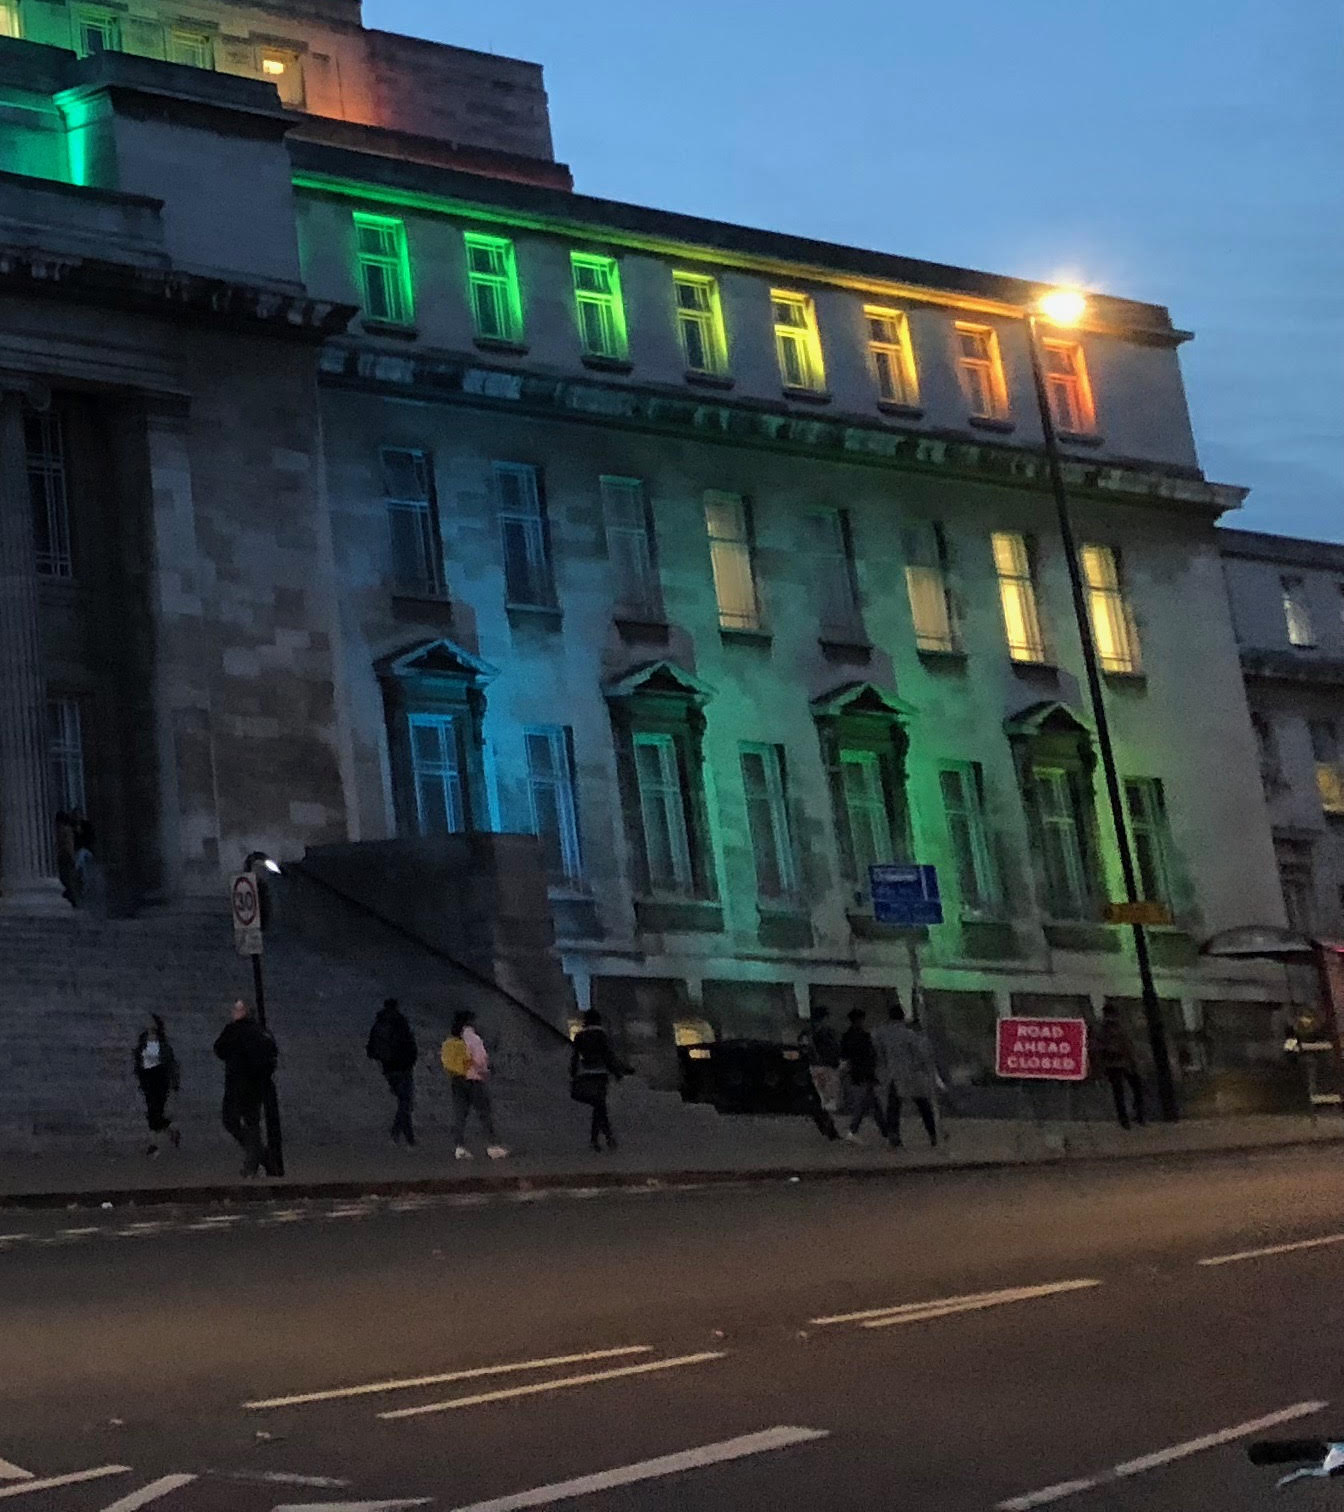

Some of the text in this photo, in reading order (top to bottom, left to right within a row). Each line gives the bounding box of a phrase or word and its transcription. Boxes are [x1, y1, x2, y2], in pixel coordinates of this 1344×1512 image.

[236, 892, 253, 911] 30
[1017, 1025, 1064, 1038] ROAD
[1014, 1041, 1071, 1054] AHEAD
[1007, 1056, 1076, 1071] CLOSED
